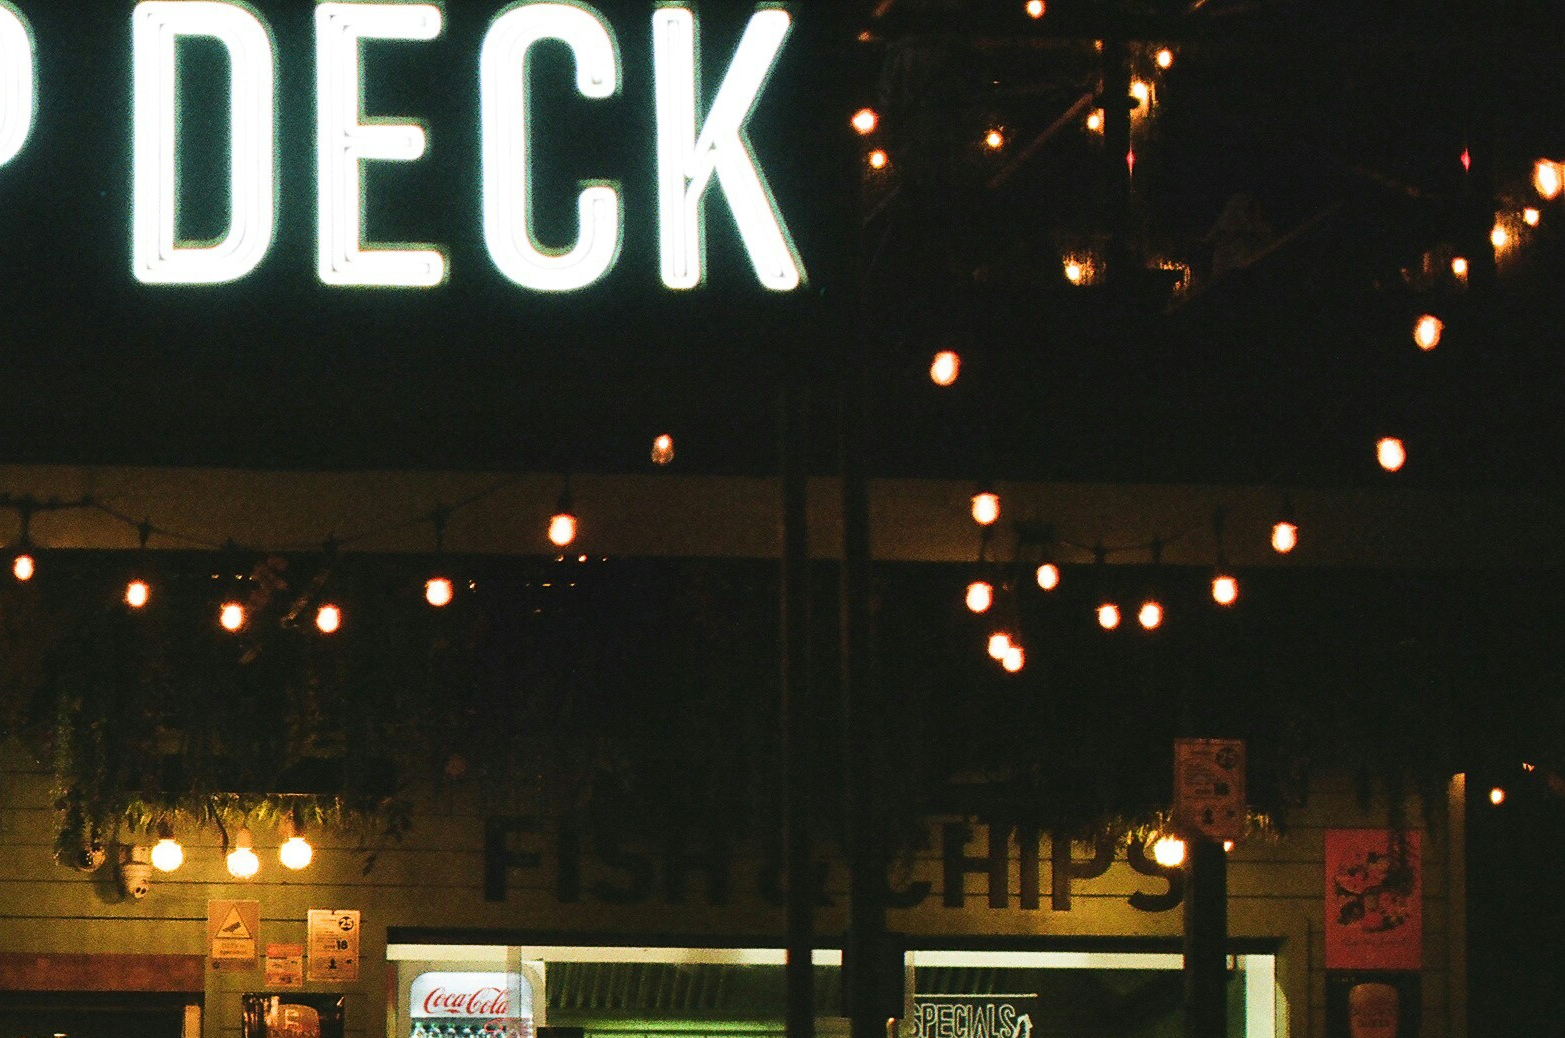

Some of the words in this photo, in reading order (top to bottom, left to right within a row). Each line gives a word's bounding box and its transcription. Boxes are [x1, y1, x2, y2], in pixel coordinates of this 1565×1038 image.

[131, 0, 808, 291] DECK
[485, 816, 727, 904] FISH
[423, 986, 508, 1016] Coca-Cola
